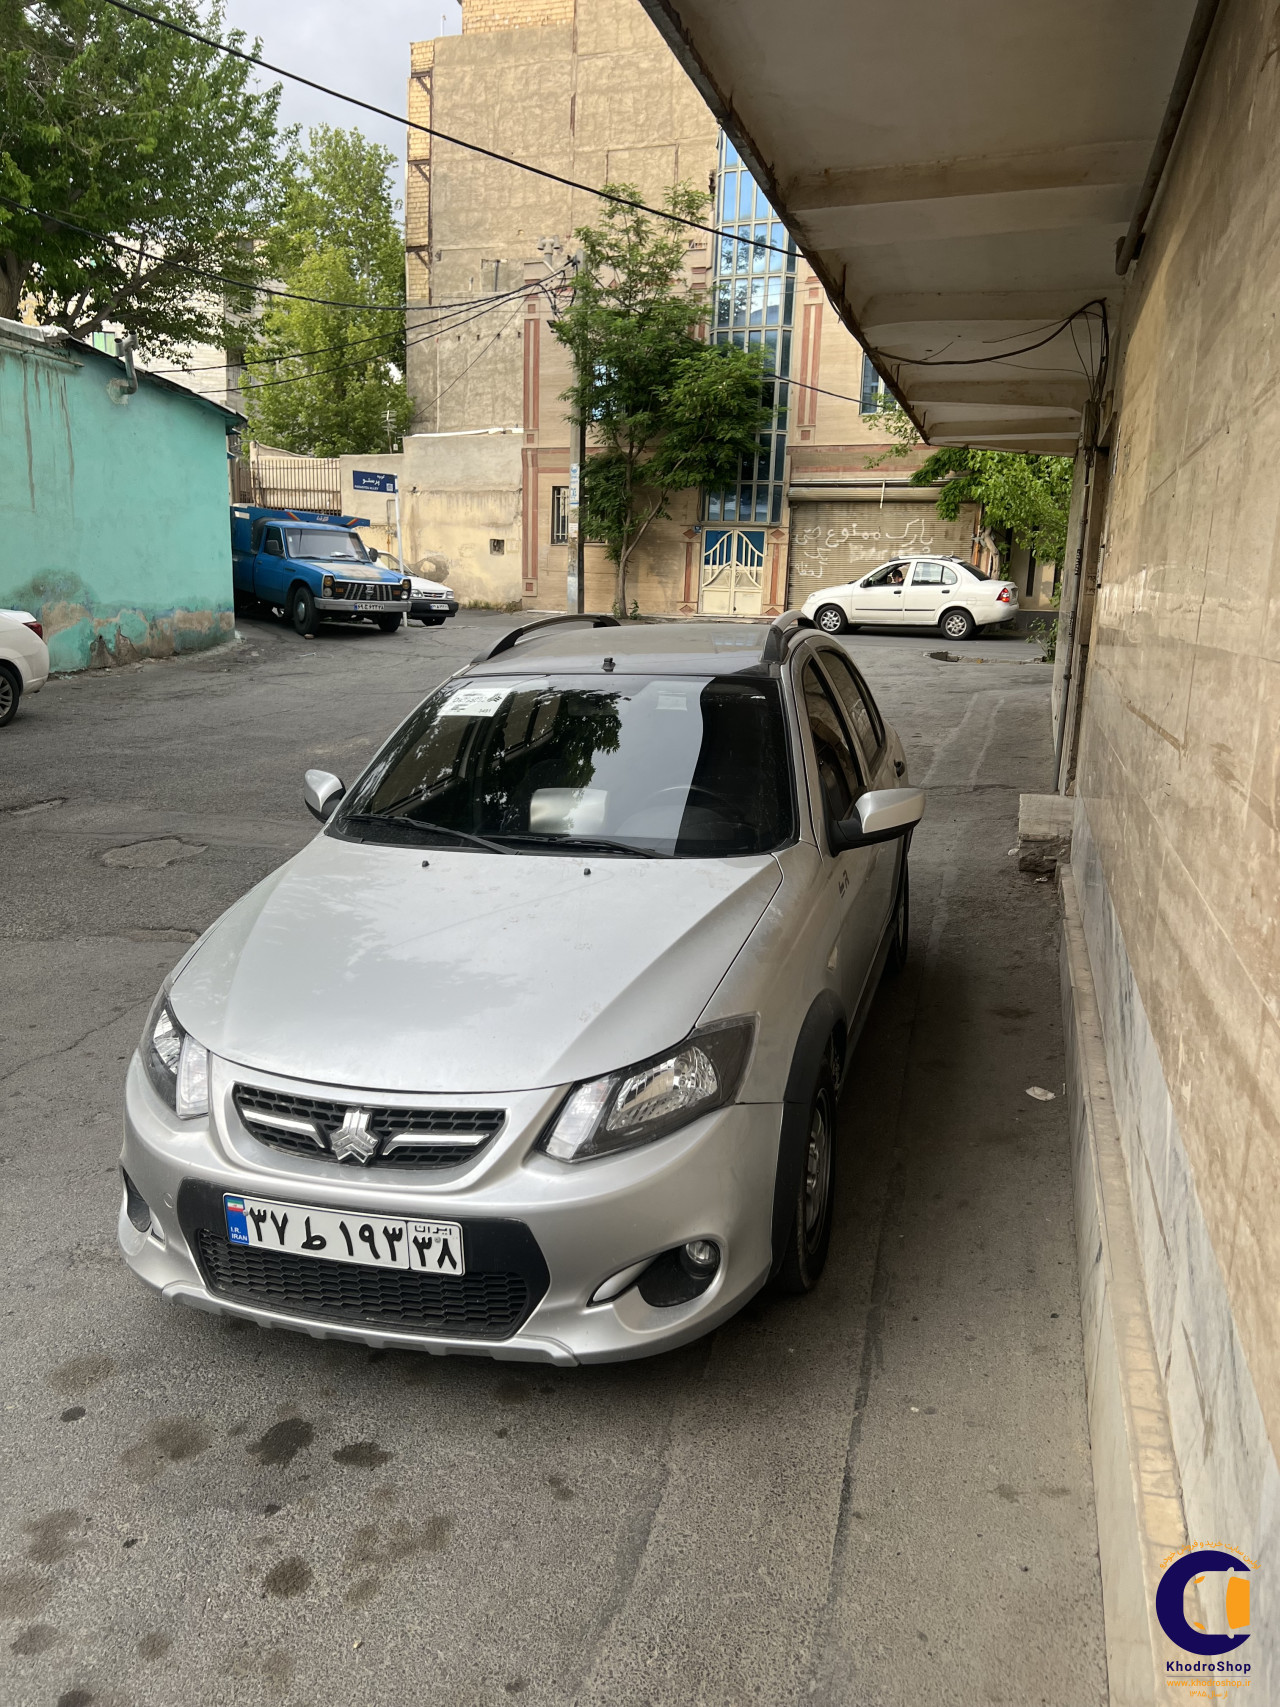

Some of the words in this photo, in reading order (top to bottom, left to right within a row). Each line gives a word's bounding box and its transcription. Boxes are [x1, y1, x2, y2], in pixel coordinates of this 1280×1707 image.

[795, 526, 821, 545] حتی
[826, 523, 881, 547] ممنوع
[886, 518, 934, 554] پارک
[795, 561, 823, 578] لحظه
[230, 1226, 242, 1234] I.R.
[231, 1233, 248, 1241] IRAN
[249, 1206, 289, 1246] ۳۷
[339, 1220, 403, 1262] ۱۹۳
[412, 1235, 458, 1270] ۳۸
[414, 1225, 452, 1236] ایران
